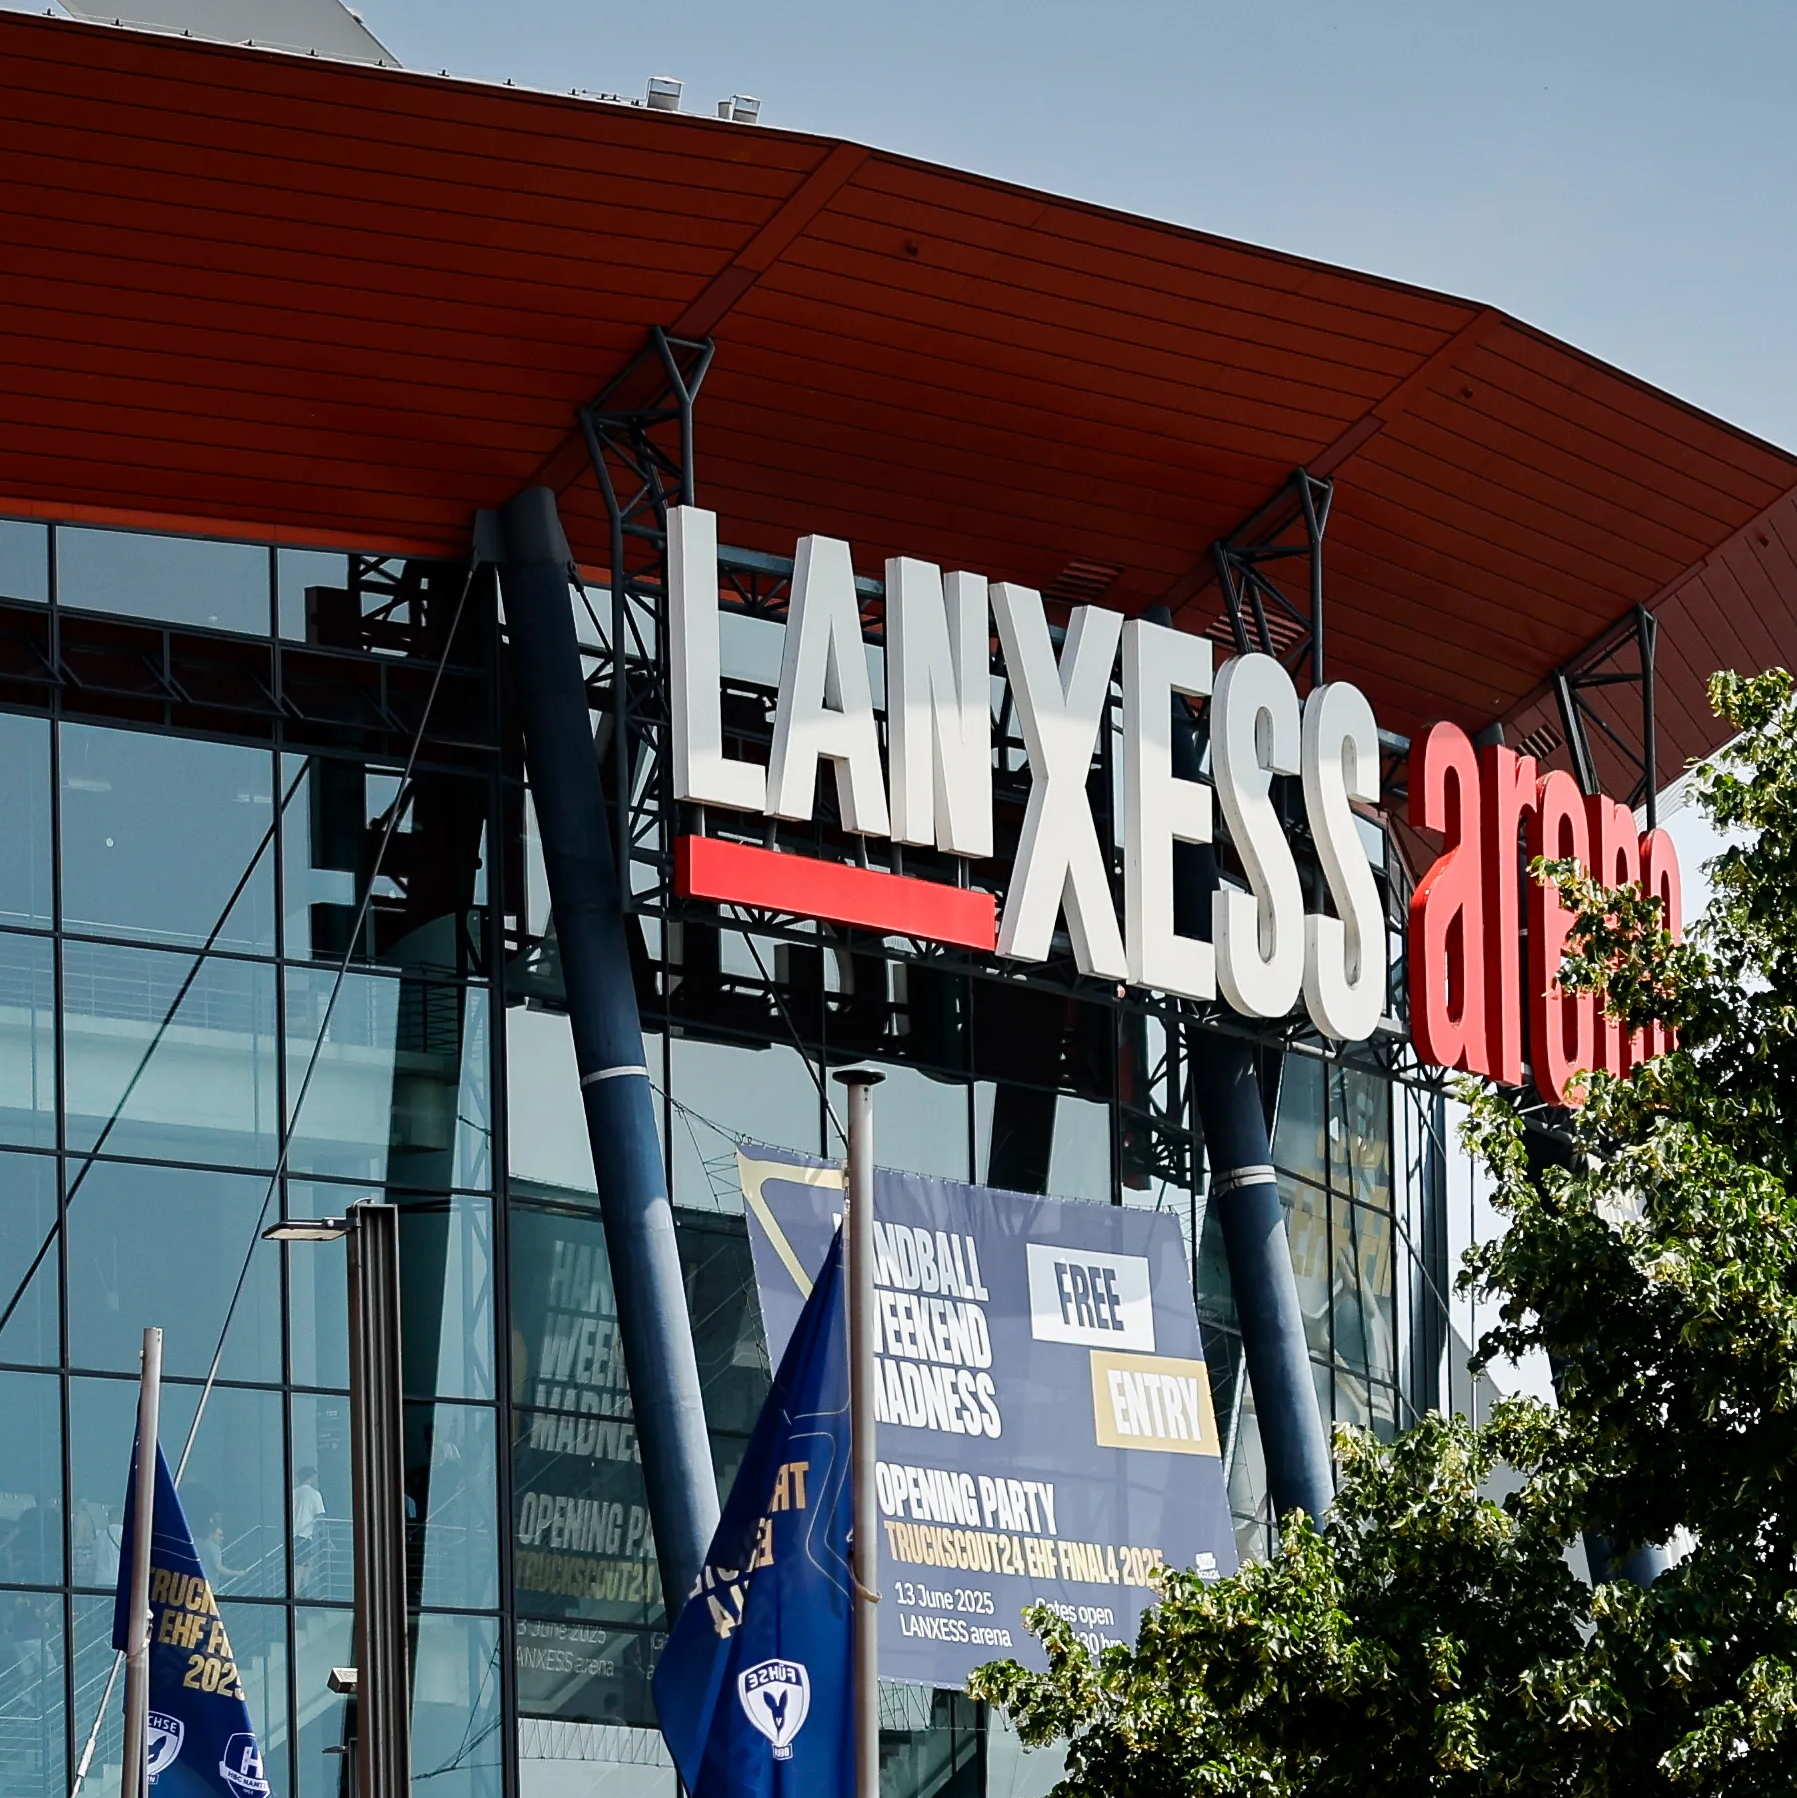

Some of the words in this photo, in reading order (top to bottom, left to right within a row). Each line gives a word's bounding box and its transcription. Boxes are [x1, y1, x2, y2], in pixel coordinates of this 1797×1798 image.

[666, 504, 1386, 1041] LANXESS
[1053, 1260, 1125, 1332] FREE
[1107, 1369, 1202, 1442] ENTRY
[875, 1461, 981, 1528] OPENING
[977, 1474, 1058, 1535] PARTY
[883, 1519, 1026, 1576] TRUCKSCOUT24
[1023, 1537, 1058, 1580] EHF
[1059, 1540, 1120, 1585] FINAL4
[158, 1609, 206, 1649] EHF
[894, 1581, 916, 1606] 13
[917, 1587, 954, 1610] June
[954, 1588, 995, 1616] 2025
[899, 1614, 969, 1645] LANXESS
[970, 1625, 1013, 1648] arena
[1078, 1606, 1115, 1630] open
